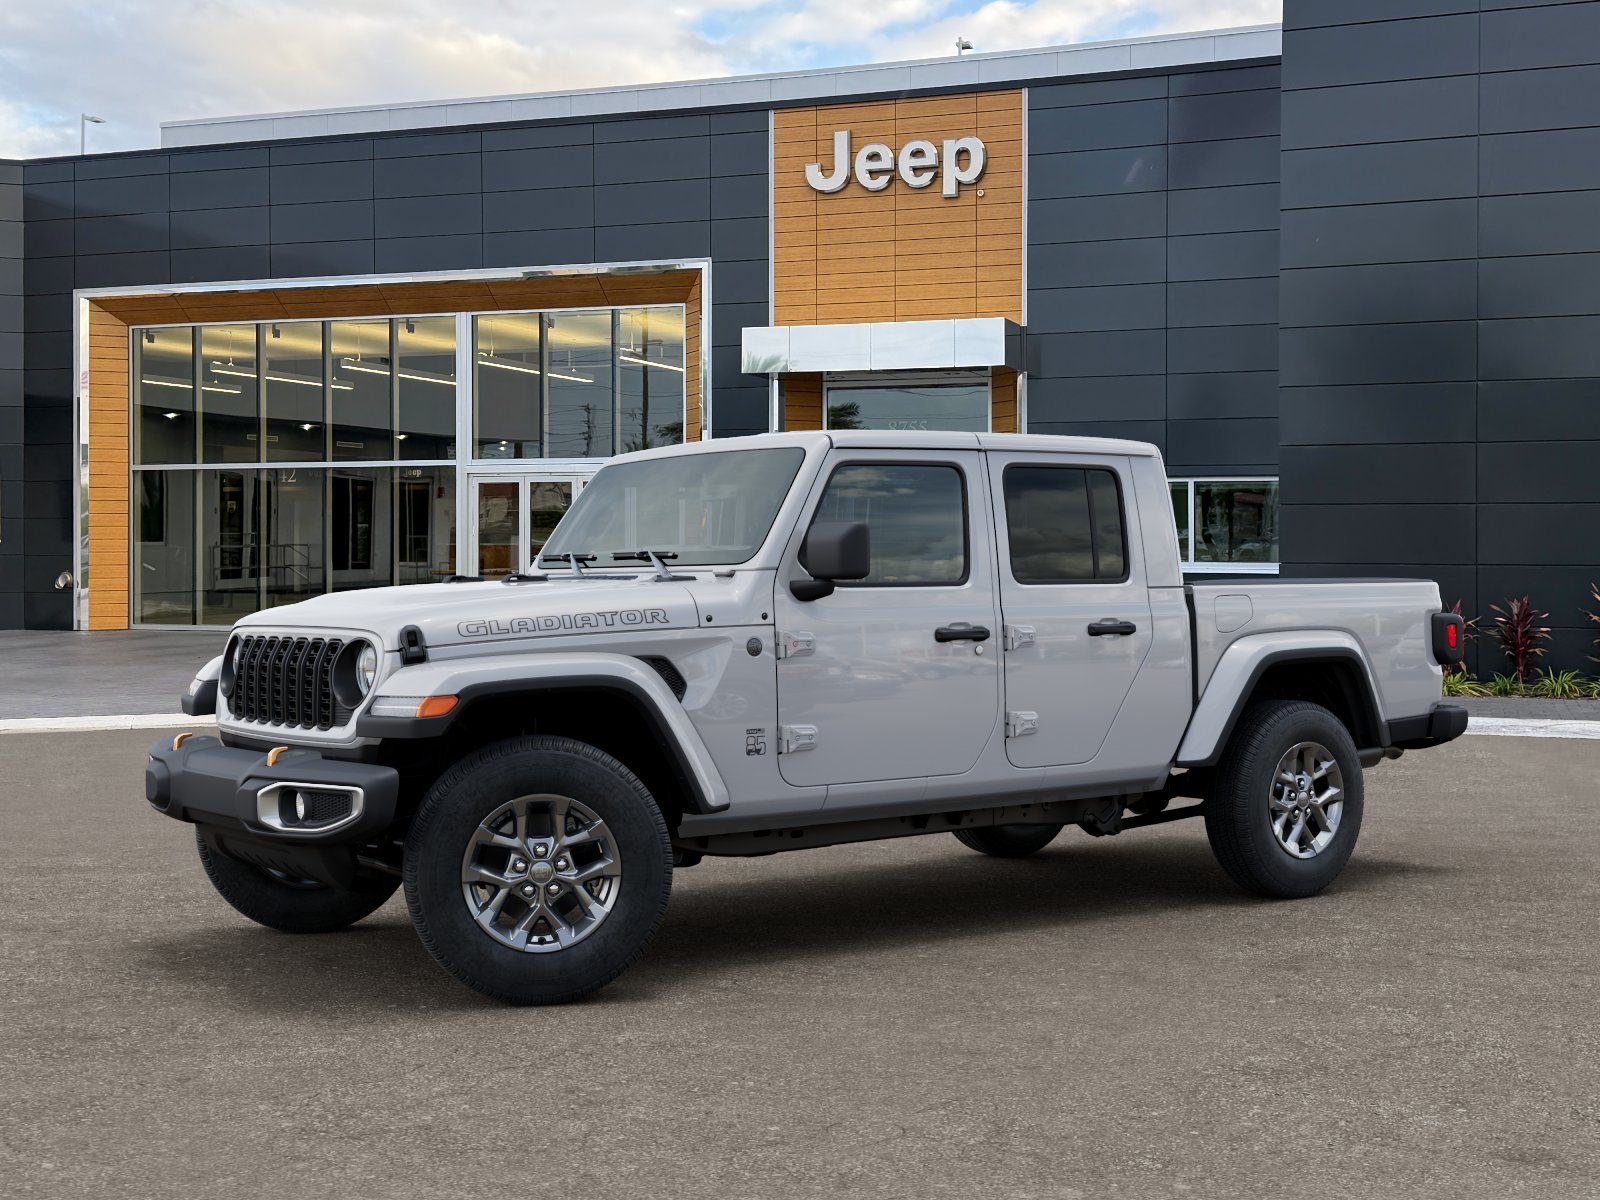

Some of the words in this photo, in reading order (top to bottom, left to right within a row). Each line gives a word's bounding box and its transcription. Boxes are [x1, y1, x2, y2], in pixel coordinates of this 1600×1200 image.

[804, 129, 987, 199] Jeep
[888, 420, 928, 431] 8755
[457, 608, 670, 638] GLADIATOR
